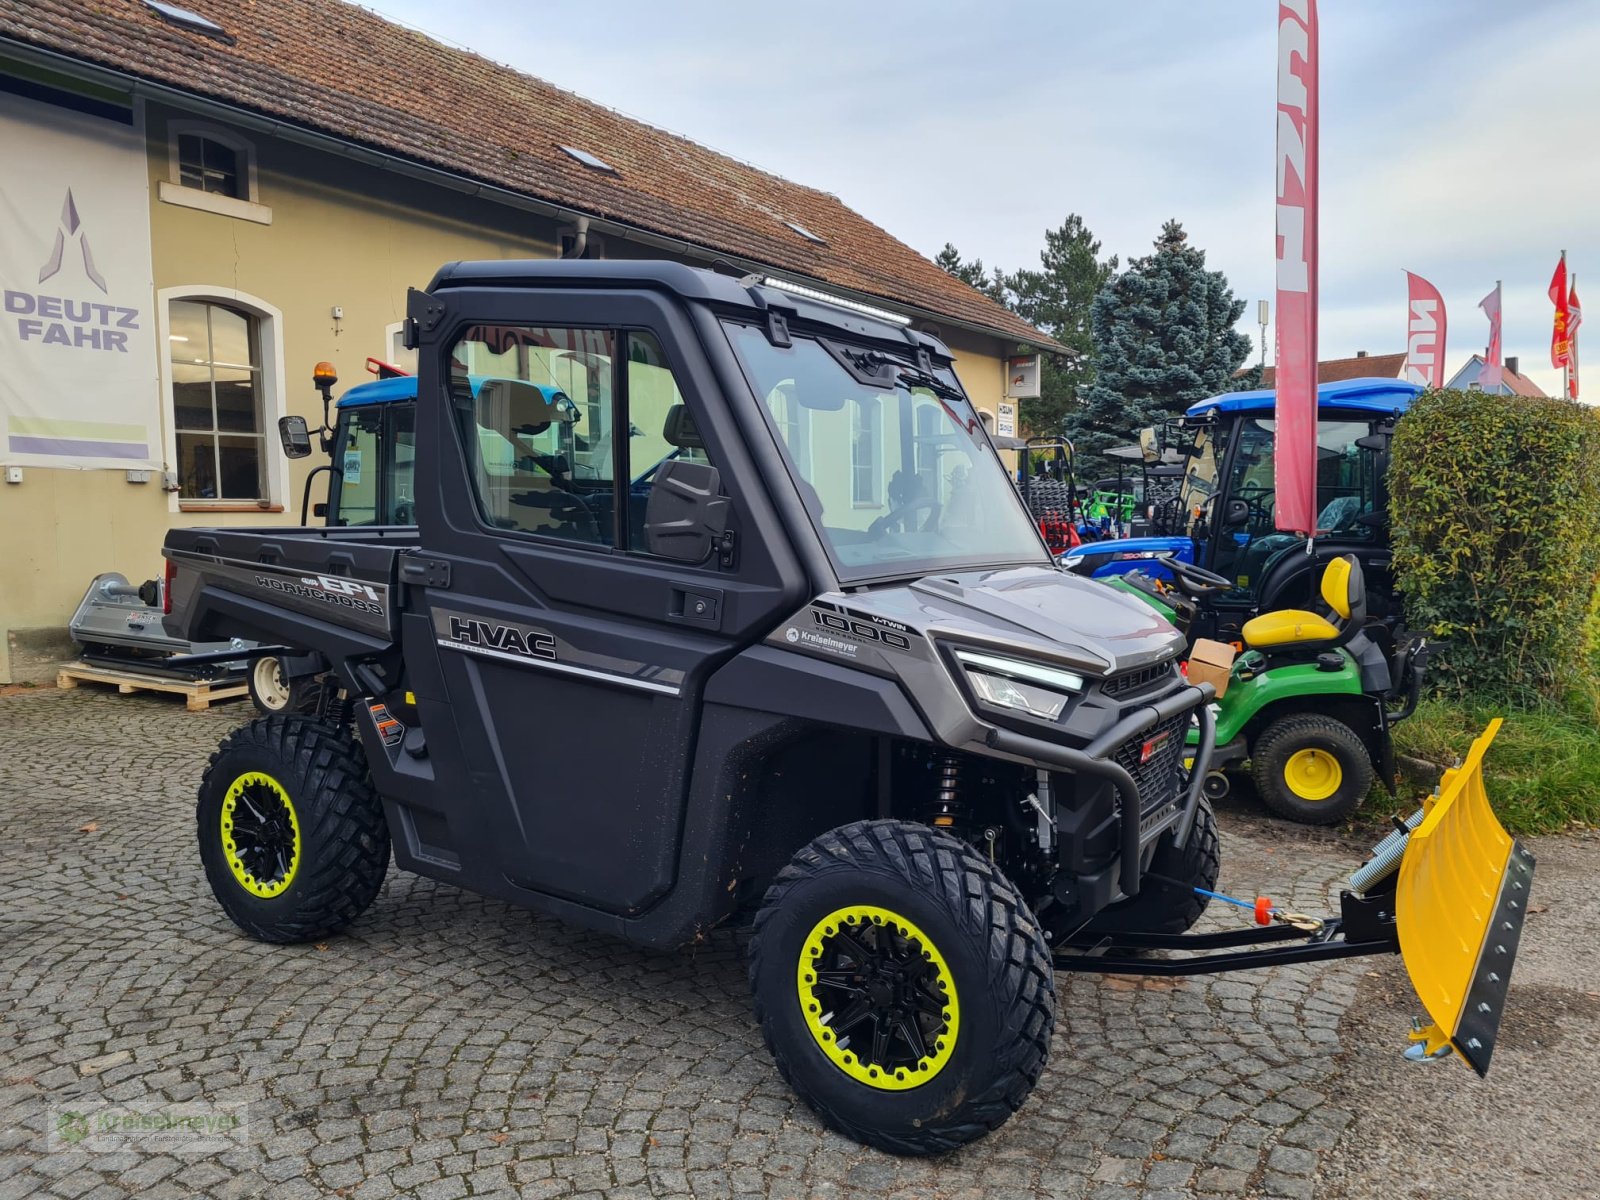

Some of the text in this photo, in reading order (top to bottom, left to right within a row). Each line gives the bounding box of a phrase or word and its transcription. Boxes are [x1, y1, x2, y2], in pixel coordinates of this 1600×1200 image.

[4, 290, 140, 329] DEUTZ
[18, 319, 128, 352] FAHR
[317, 575, 379, 601] EFI
[449, 616, 556, 660] HVAC
[811, 609, 912, 652] 1000
[872, 616, 907, 632] V-TWIN
[801, 630, 858, 653] Kreiselmeyer
